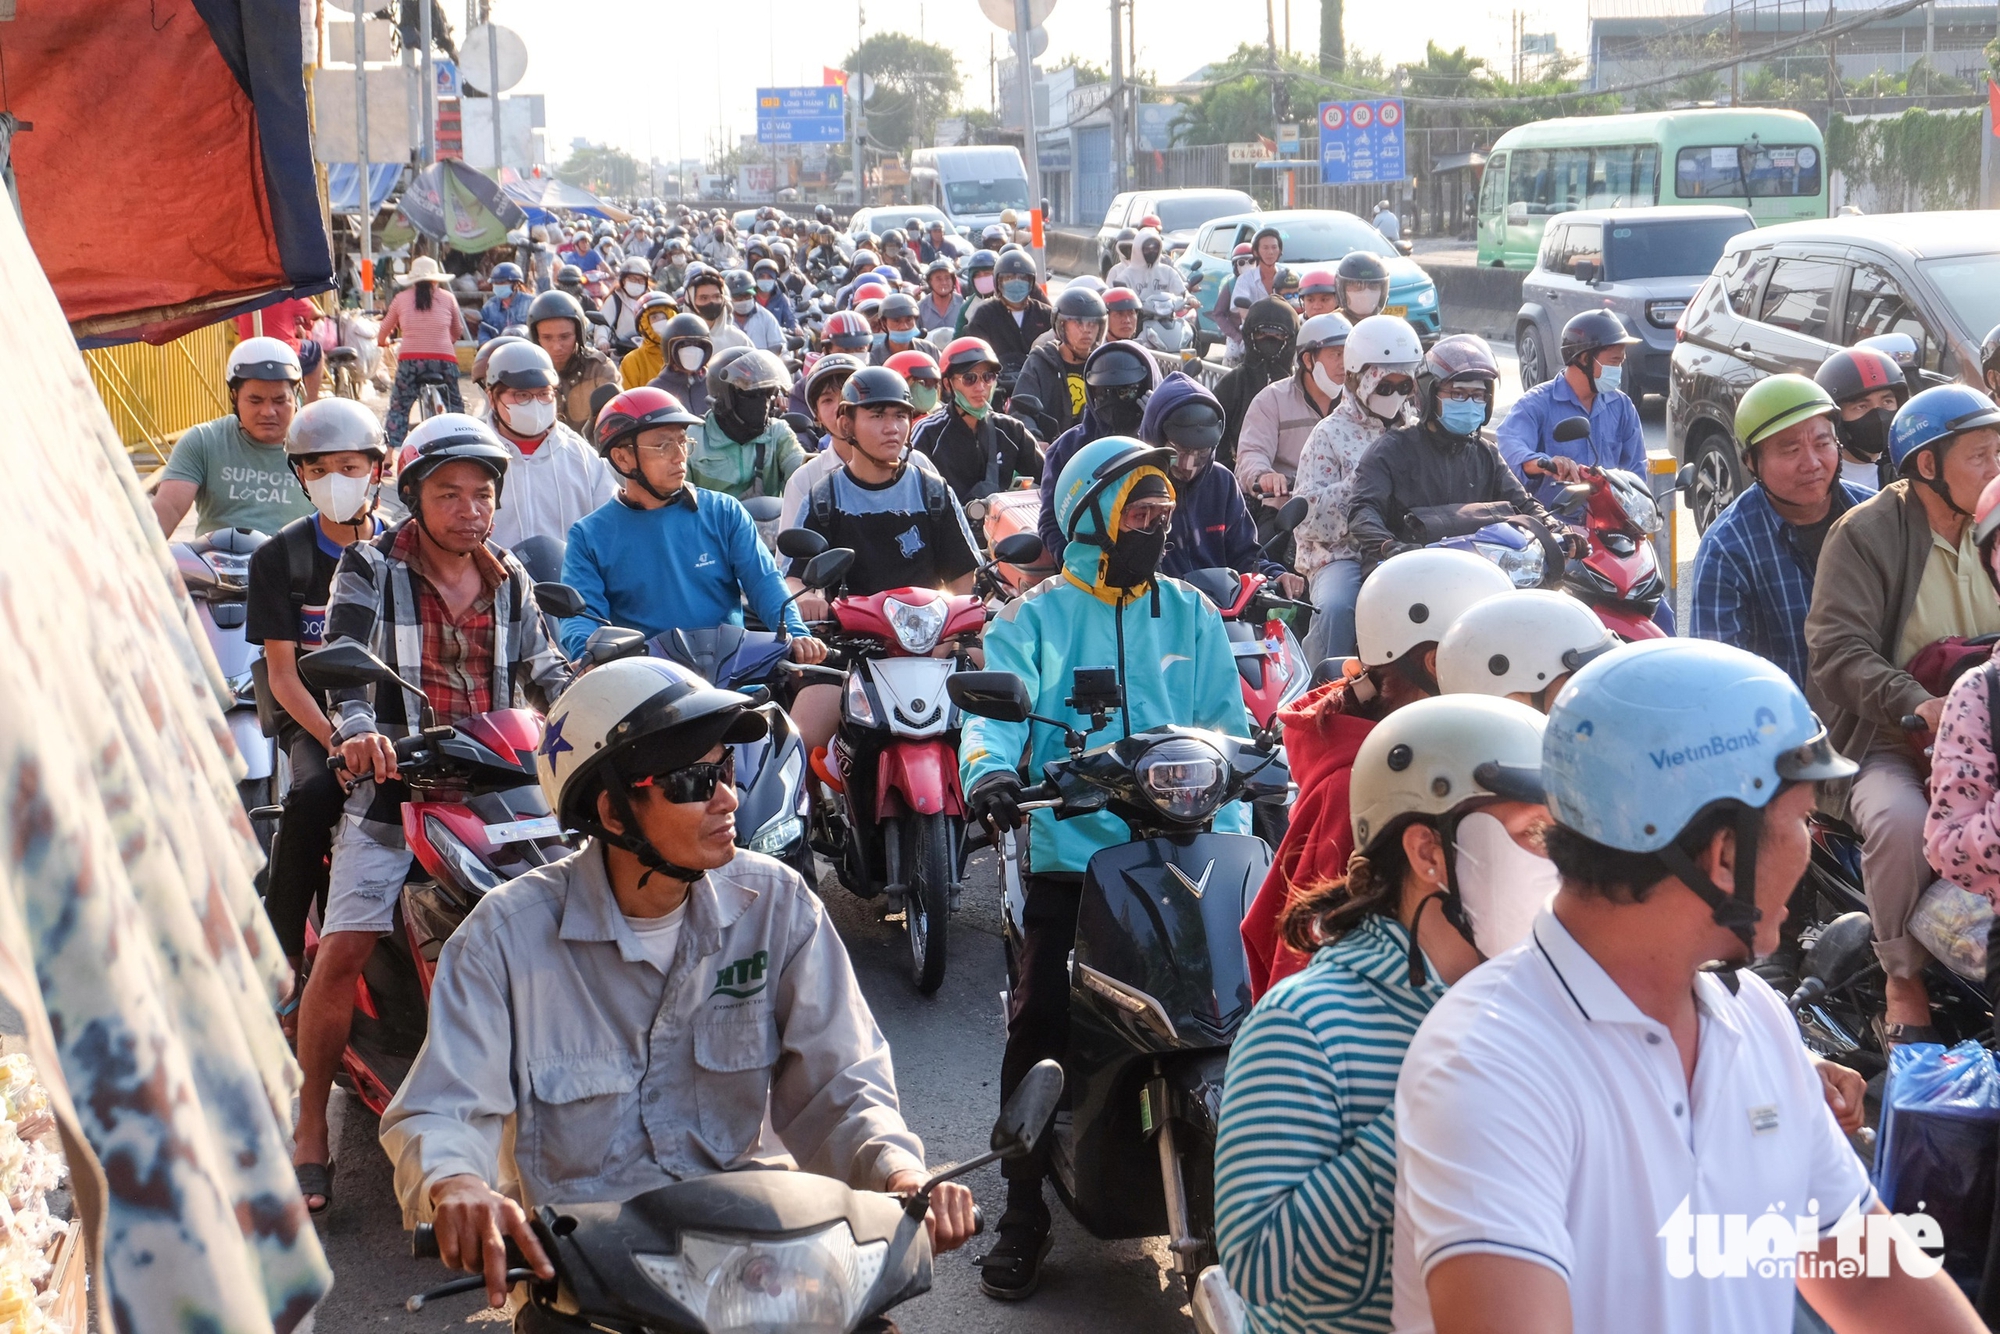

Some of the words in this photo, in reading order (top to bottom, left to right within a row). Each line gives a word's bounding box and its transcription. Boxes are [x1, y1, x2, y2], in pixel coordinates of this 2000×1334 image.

[1328, 112, 1339, 122] 60
[1356, 110, 1367, 121] 60
[1384, 109, 1395, 120] 60
[828, 126, 839, 134] km
[1896, 428, 1917, 443] Honda
[1916, 420, 1929, 430] ITC
[221, 466, 301, 489] SUPPOR
[1069, 478, 1084, 497] SM
[1649, 727, 1761, 771] VietinBank
[714, 950, 768, 988] HTP
